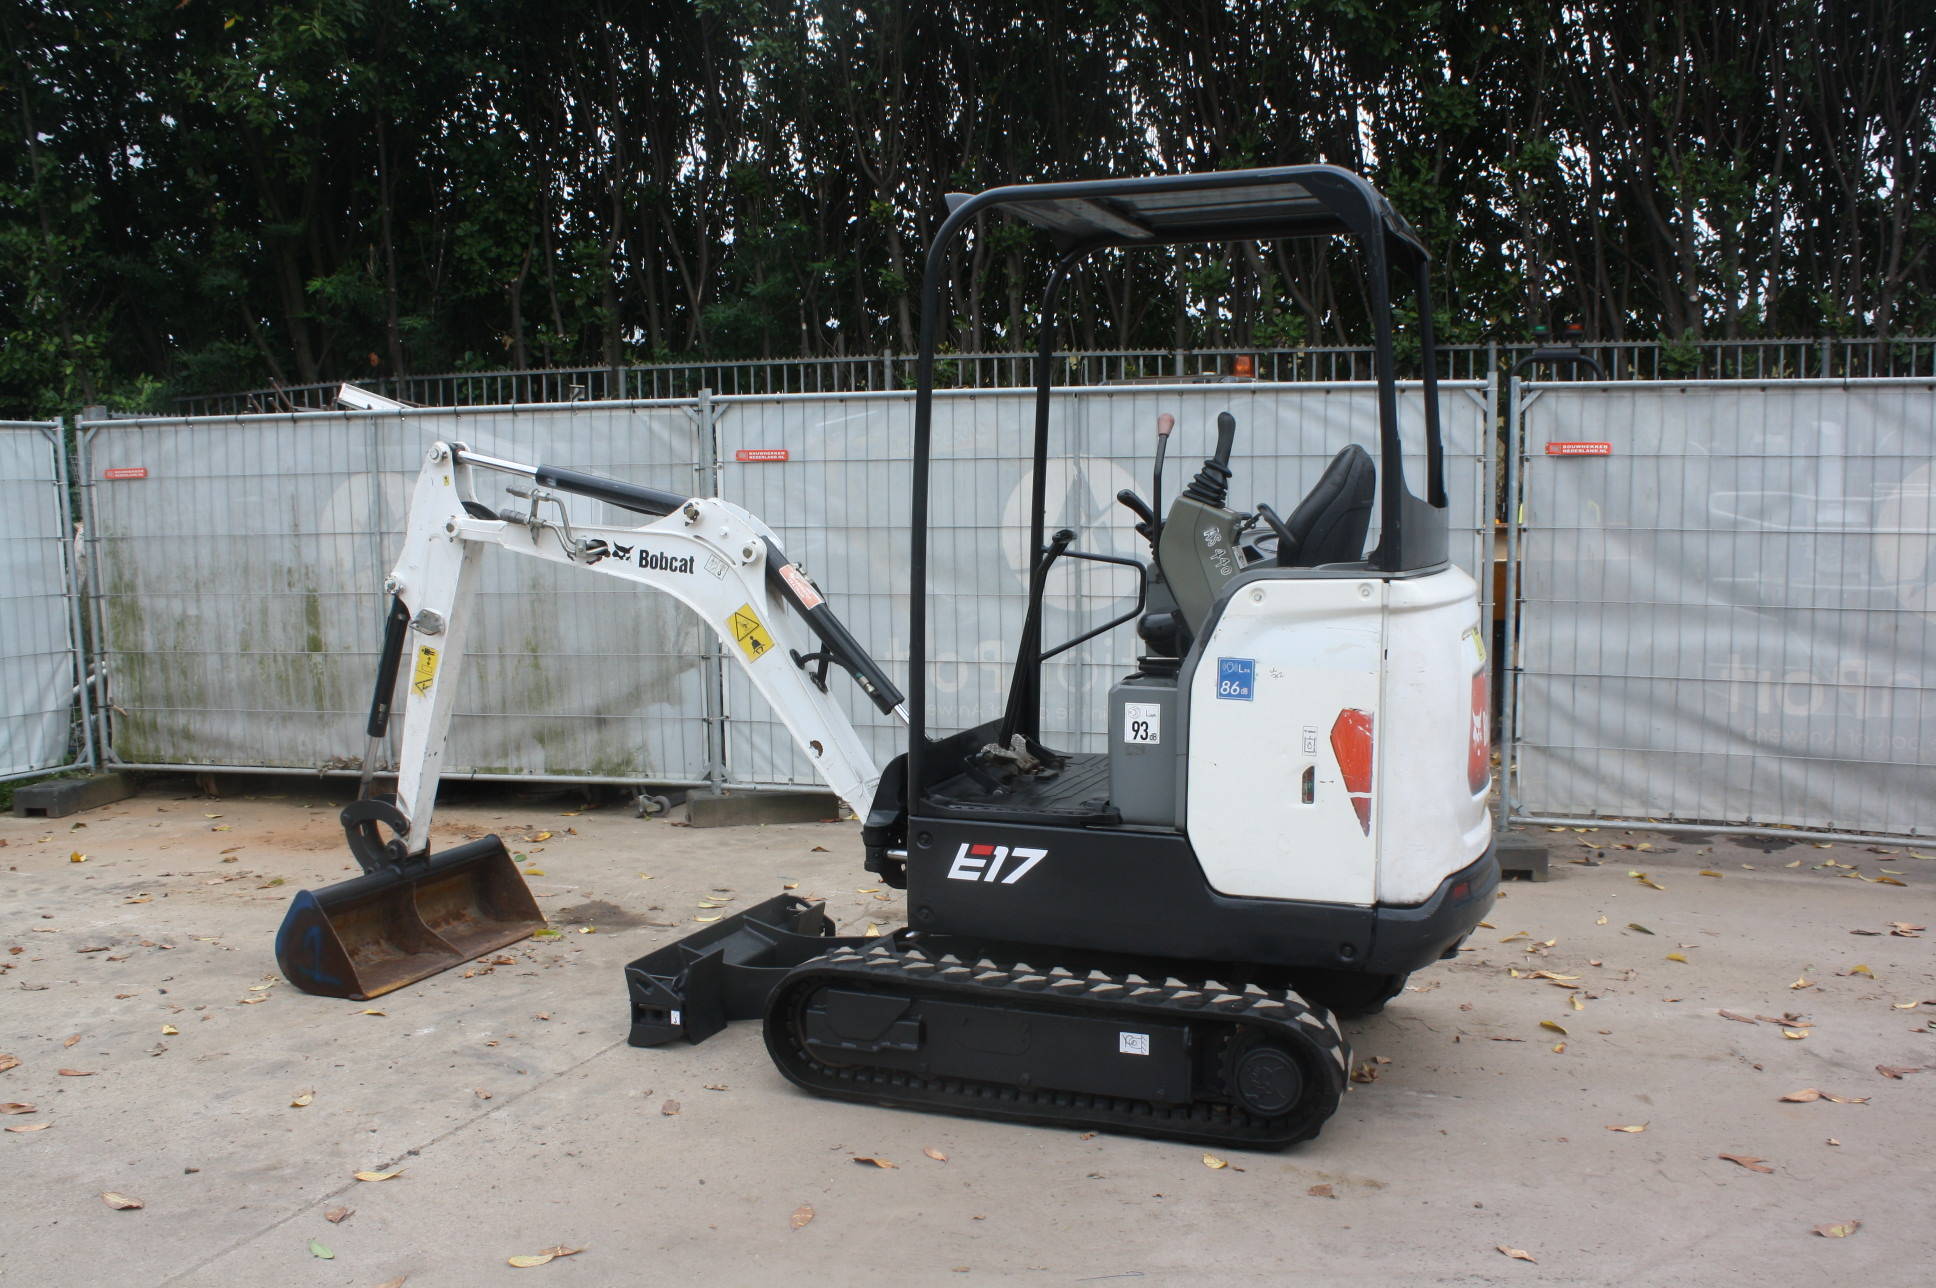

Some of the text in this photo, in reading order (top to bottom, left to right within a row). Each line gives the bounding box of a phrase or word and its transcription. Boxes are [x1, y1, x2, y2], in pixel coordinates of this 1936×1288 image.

[638, 549, 695, 575] Bobcat
[1210, 548, 1233, 576] 440
[1220, 680, 1240, 695] 86
[1131, 720, 1158, 741] 93 dB
[947, 843, 1048, 884] E17
